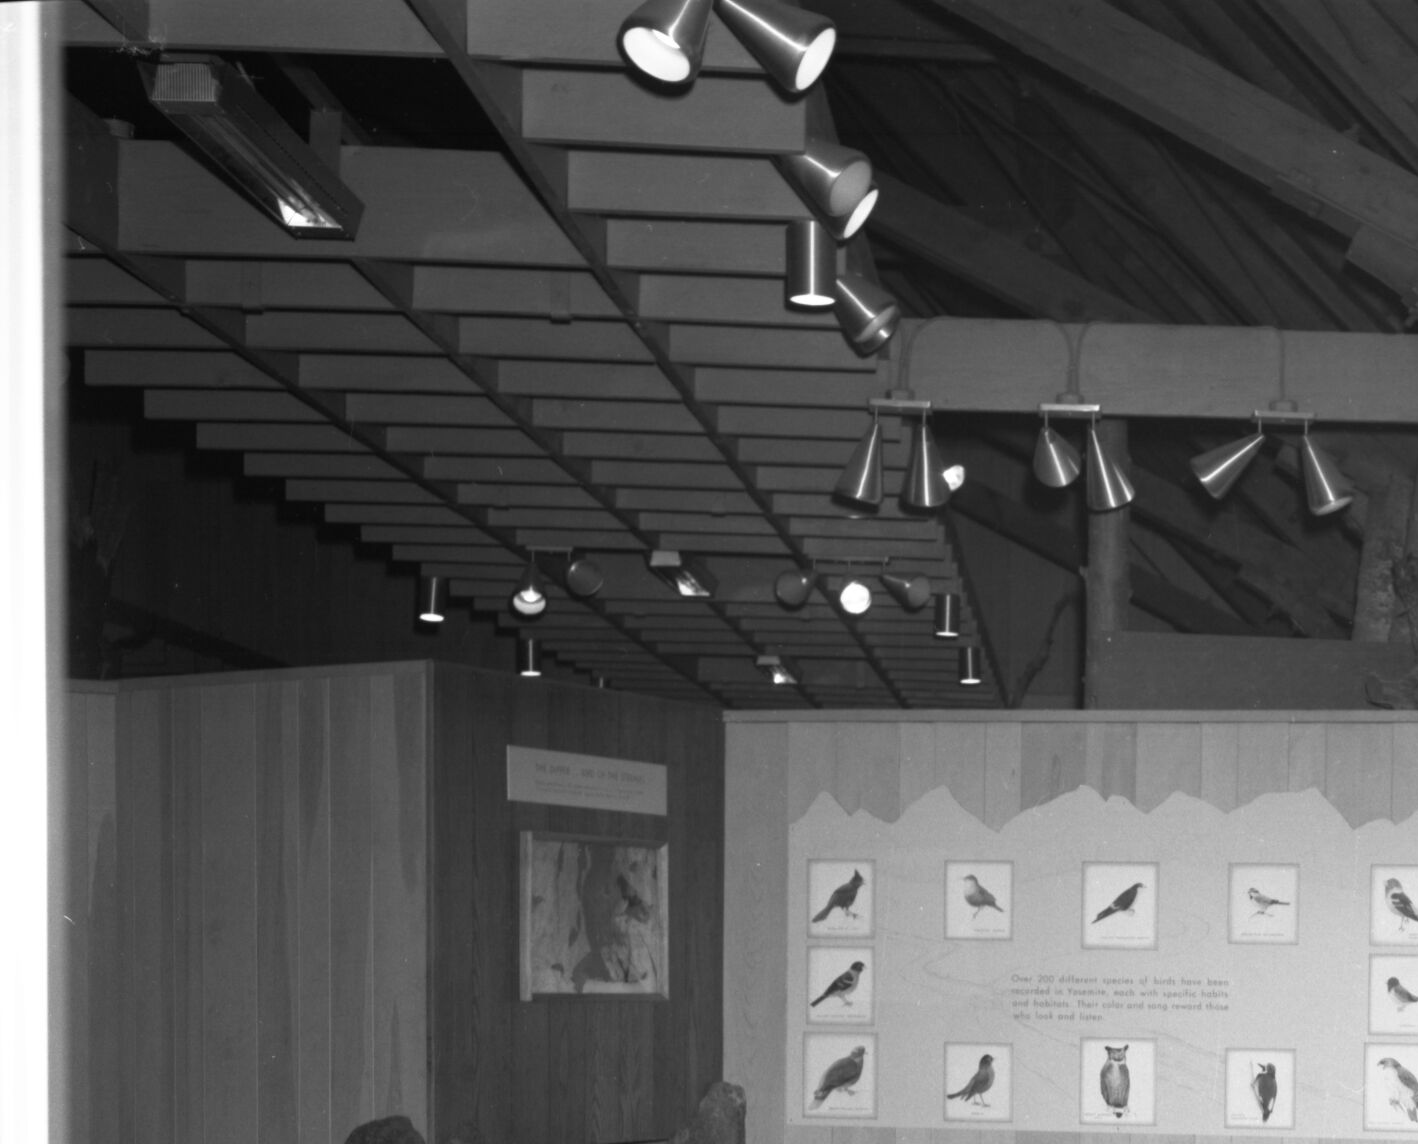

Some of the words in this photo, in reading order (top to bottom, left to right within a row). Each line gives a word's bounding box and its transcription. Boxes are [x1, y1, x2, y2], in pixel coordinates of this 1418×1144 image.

[1011, 974, 1033, 984] Over
[1037, 974, 1055, 985] 200
[1058, 974, 1099, 985] different
[1102, 975, 1134, 987] species
[1138, 975, 1150, 987] of
[1153, 975, 1177, 987] birds
[1180, 976, 1202, 987] have
[1207, 976, 1230, 987] been
[1010, 986, 1050, 997] recorded
[1054, 987, 1064, 997] in
[1113, 988, 1136, 998] each
[1140, 988, 1160, 999] with
[1163, 989, 1198, 1001] specific
[1201, 989, 1229, 1000] habits
[1011, 998, 1030, 1008] and
[1076, 999, 1099, 1010] Their
[1102, 1000, 1124, 1010] color
[1127, 1001, 1145, 1011] and
[1147, 1002, 1168, 1013] song
[1171, 1001, 1203, 1011] reward
[1205, 1001, 1230, 1012] those
[1013, 1011, 1031, 1021] who
[1035, 1011, 1054, 1022] look
[1058, 1011, 1075, 1022] and
